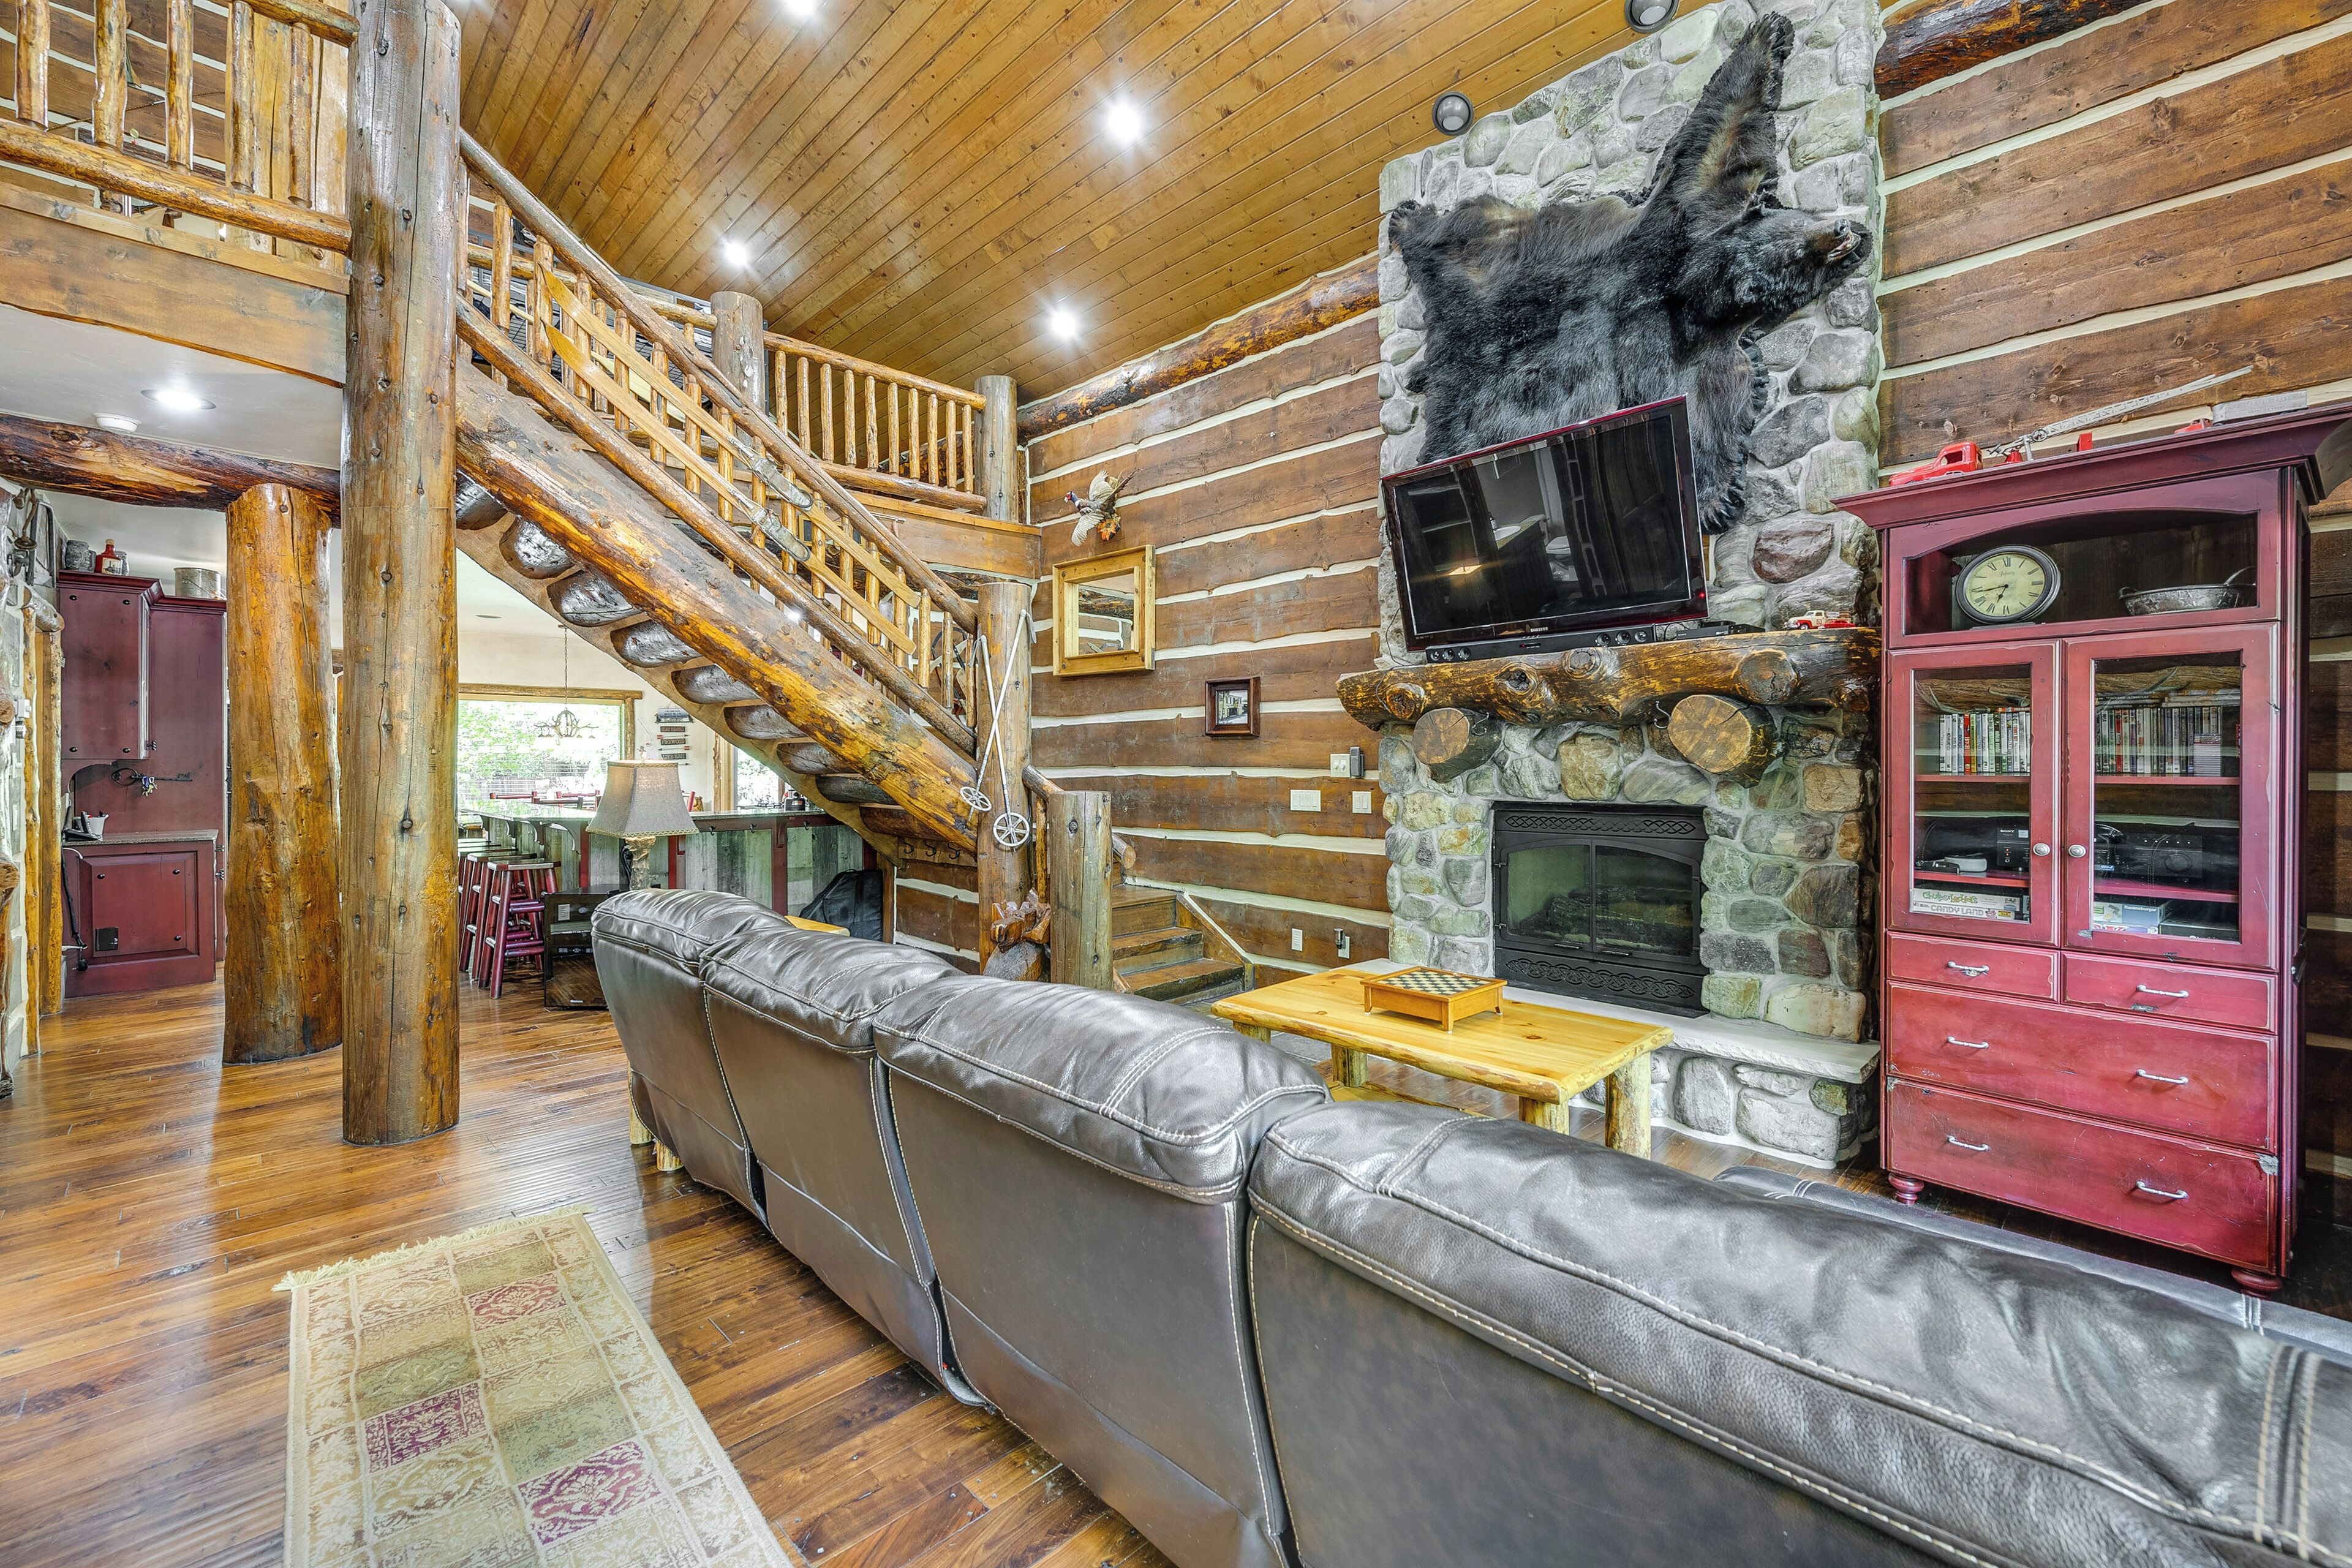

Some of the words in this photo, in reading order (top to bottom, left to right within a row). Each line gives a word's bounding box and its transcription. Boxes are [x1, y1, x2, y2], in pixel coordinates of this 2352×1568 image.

[1923, 891, 1948, 902] Chutes
[1950, 894, 1978, 903] Ladders
[1931, 905, 1959, 913] CANDY
